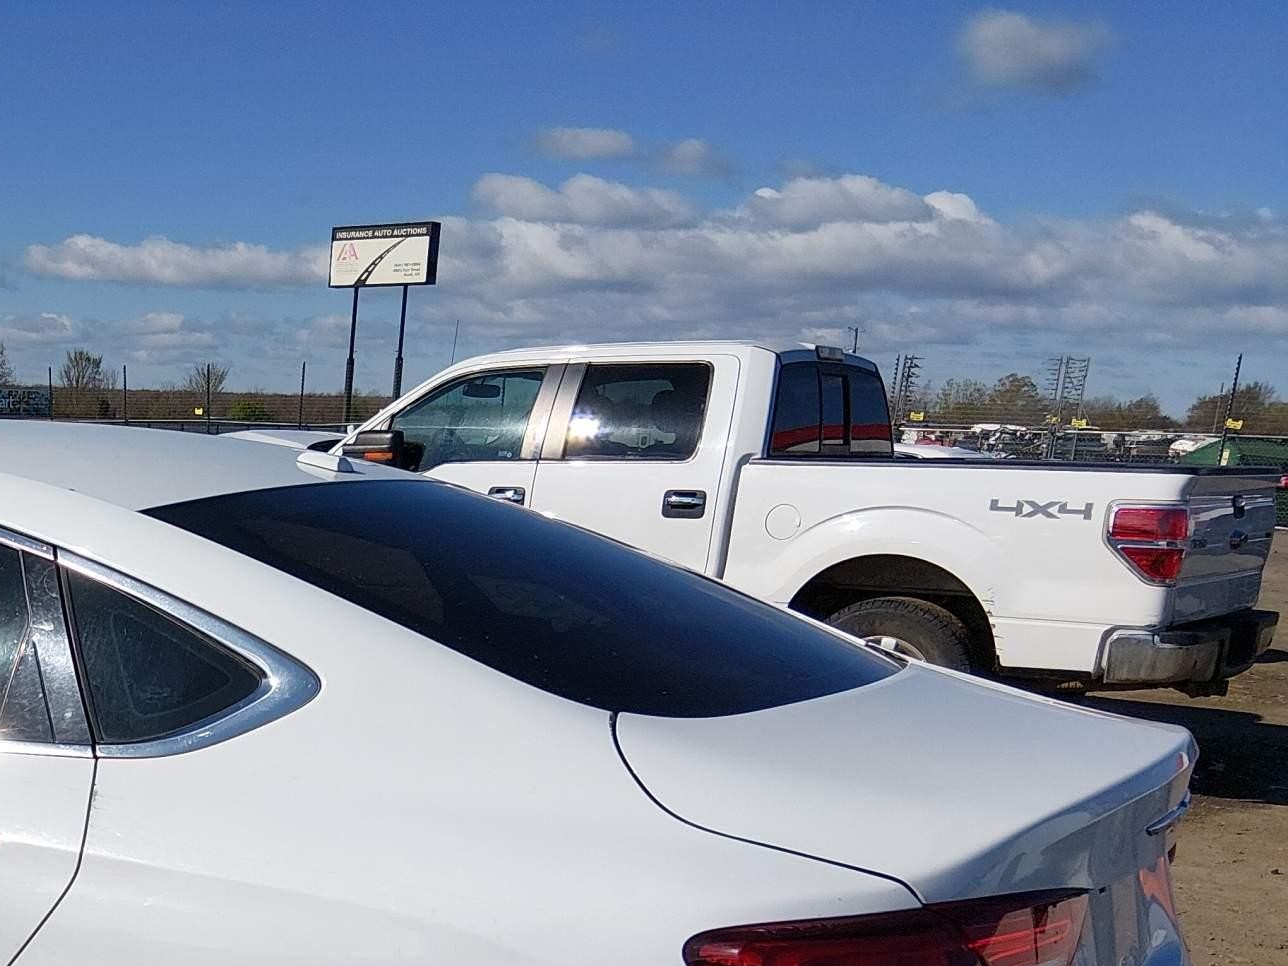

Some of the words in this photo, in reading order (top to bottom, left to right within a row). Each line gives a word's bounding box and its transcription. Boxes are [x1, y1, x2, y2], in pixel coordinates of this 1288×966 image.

[336, 230, 373, 239] INSURANCE
[374, 228, 392, 237] AUTO
[393, 227, 427, 236] AUCTIONS
